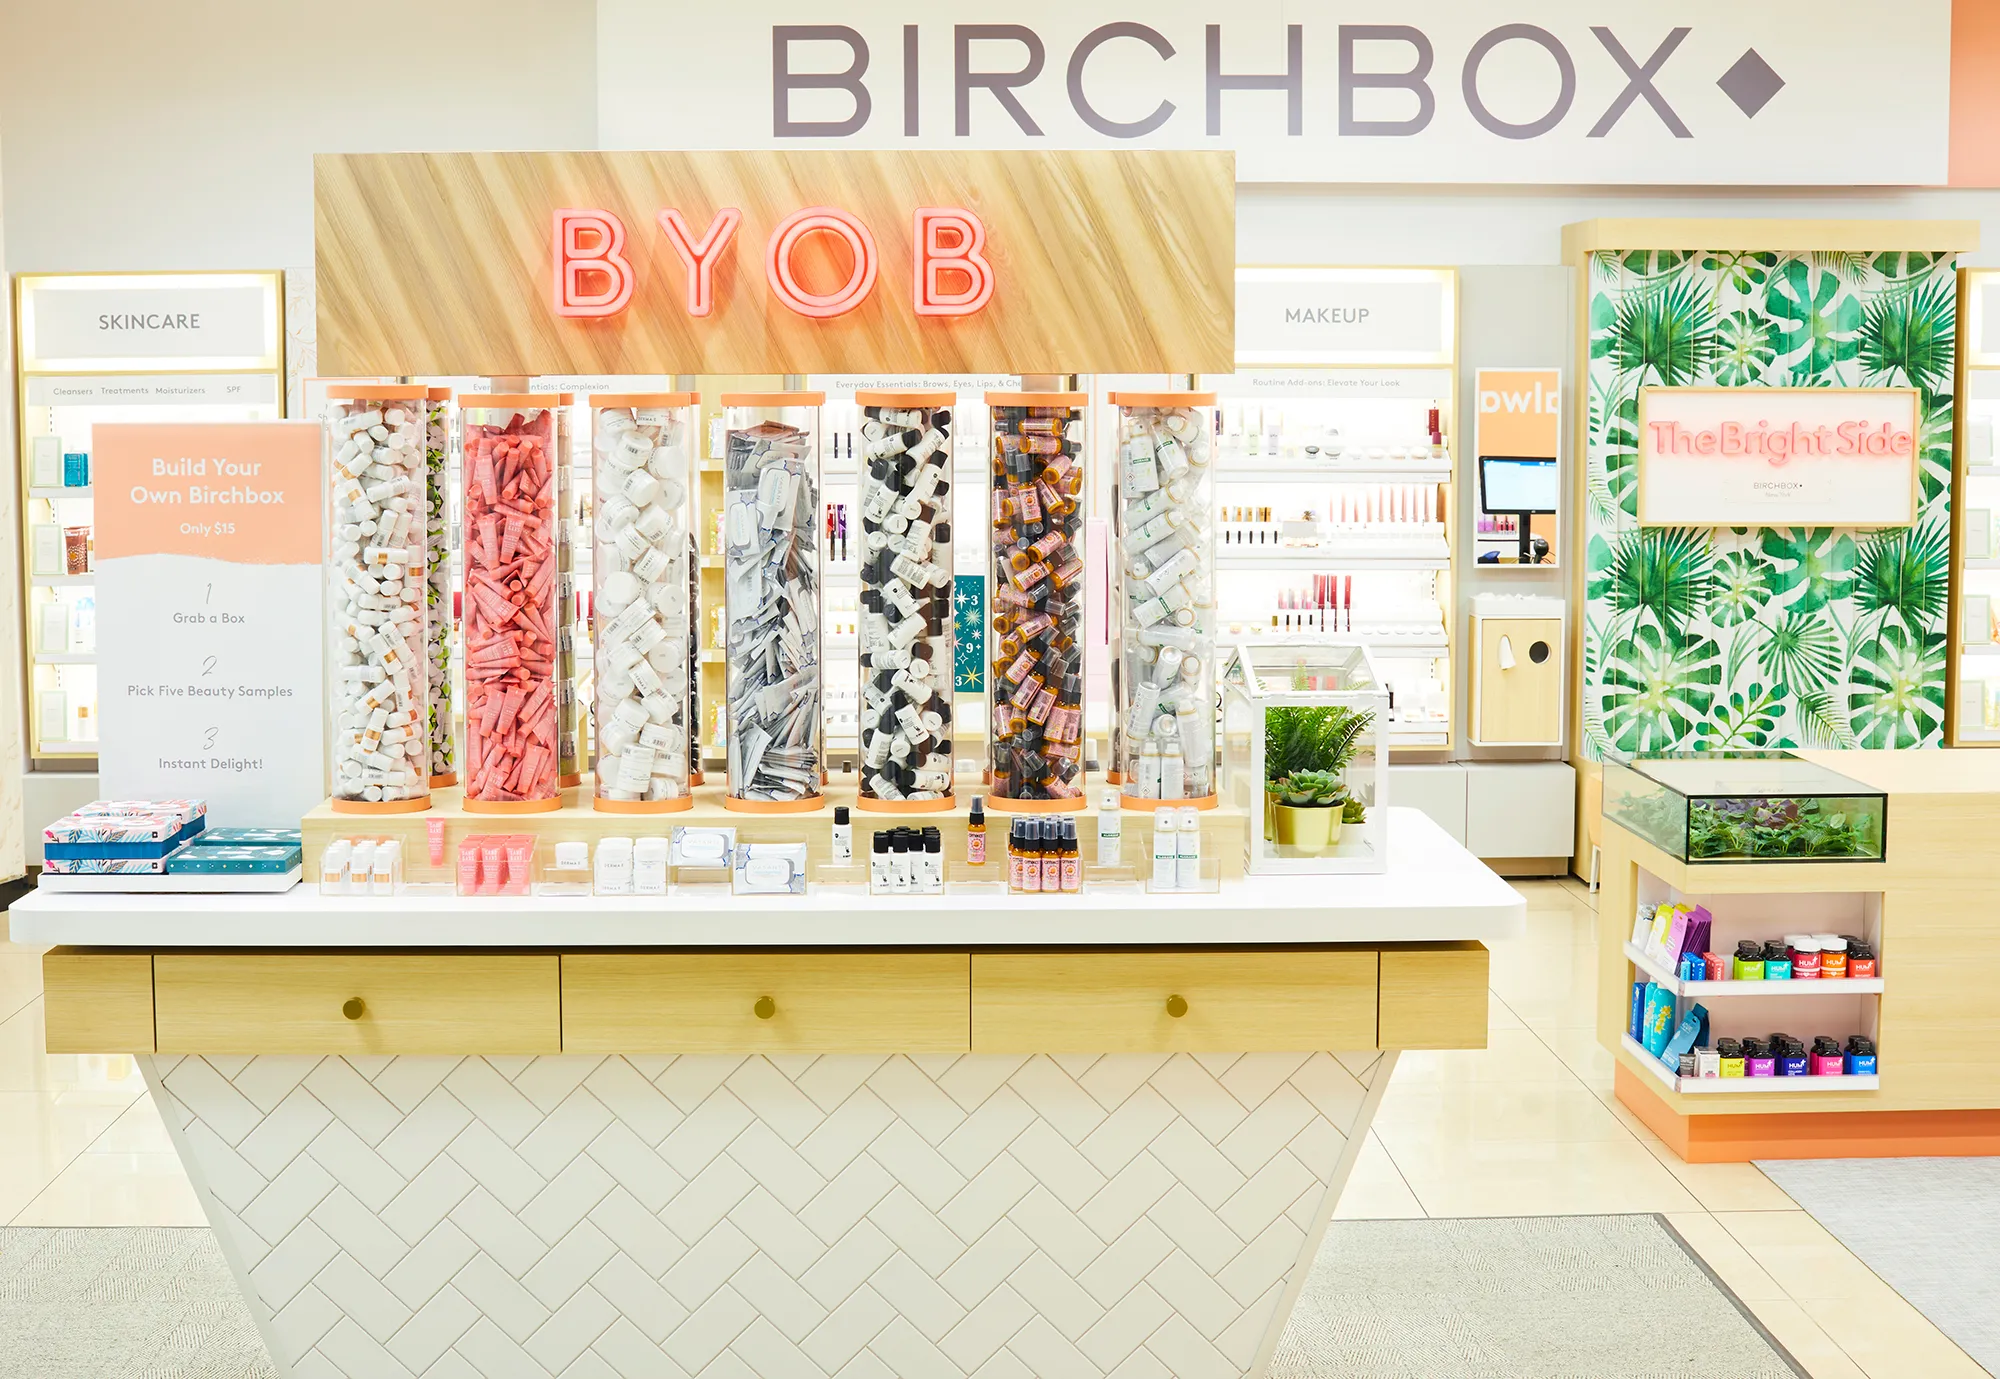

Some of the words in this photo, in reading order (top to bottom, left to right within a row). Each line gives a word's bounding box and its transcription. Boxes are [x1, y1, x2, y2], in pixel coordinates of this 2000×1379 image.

[772, 22, 1694, 139] BIRCHBOX
[553, 206, 996, 319] BYOB
[99, 314, 200, 330] SKINCARE
[1285, 308, 1370, 323] MAKEUP
[559, 382, 610, 392] Complexion
[835, 380, 874, 389] Everyday
[876, 380, 921, 388] Essentials:
[923, 380, 951, 389] Brows,
[953, 380, 975, 389] Eyes,
[976, 379, 997, 389] Lips,
[1252, 378, 1286, 387] Routine
[1287, 378, 1326, 387] Add-ons:
[1327, 378, 1358, 387] Elevate
[1360, 378, 1379, 387] Your
[1381, 378, 1401, 387] Look
[53, 387, 93, 396] Cleansers
[101, 387, 149, 395] Treatments
[155, 386, 206, 395] Moisturizers
[226, 386, 241, 394] SPF
[1649, 420, 1717, 455] The
[1720, 419, 1833, 467] Bright
[1837, 419, 1913, 455] Side
[152, 458, 206, 477] Build
[212, 459, 262, 477] Your
[1753, 482, 1799, 490] BIRCHBOX
[130, 487, 182, 505] Own
[189, 486, 284, 505] Birchbox
[180, 522, 212, 540] Only
[214, 521, 236, 536] $15
[205, 582, 213, 605] 1
[970, 594, 979, 606] 3
[173, 613, 206, 624] Grab
[209, 615, 218, 624] a
[221, 613, 245, 624] Box
[965, 642, 974, 653] 9
[201, 655, 218, 677] 2
[954, 675, 963, 687] 3
[127, 685, 155, 697] Pick
[158, 685, 185, 697] Five
[188, 685, 235, 701] Beauty
[238, 685, 293, 701] Samples
[203, 727, 219, 751] 3
[158, 758, 206, 770] Instant
[210, 757, 264, 774] Delight!
